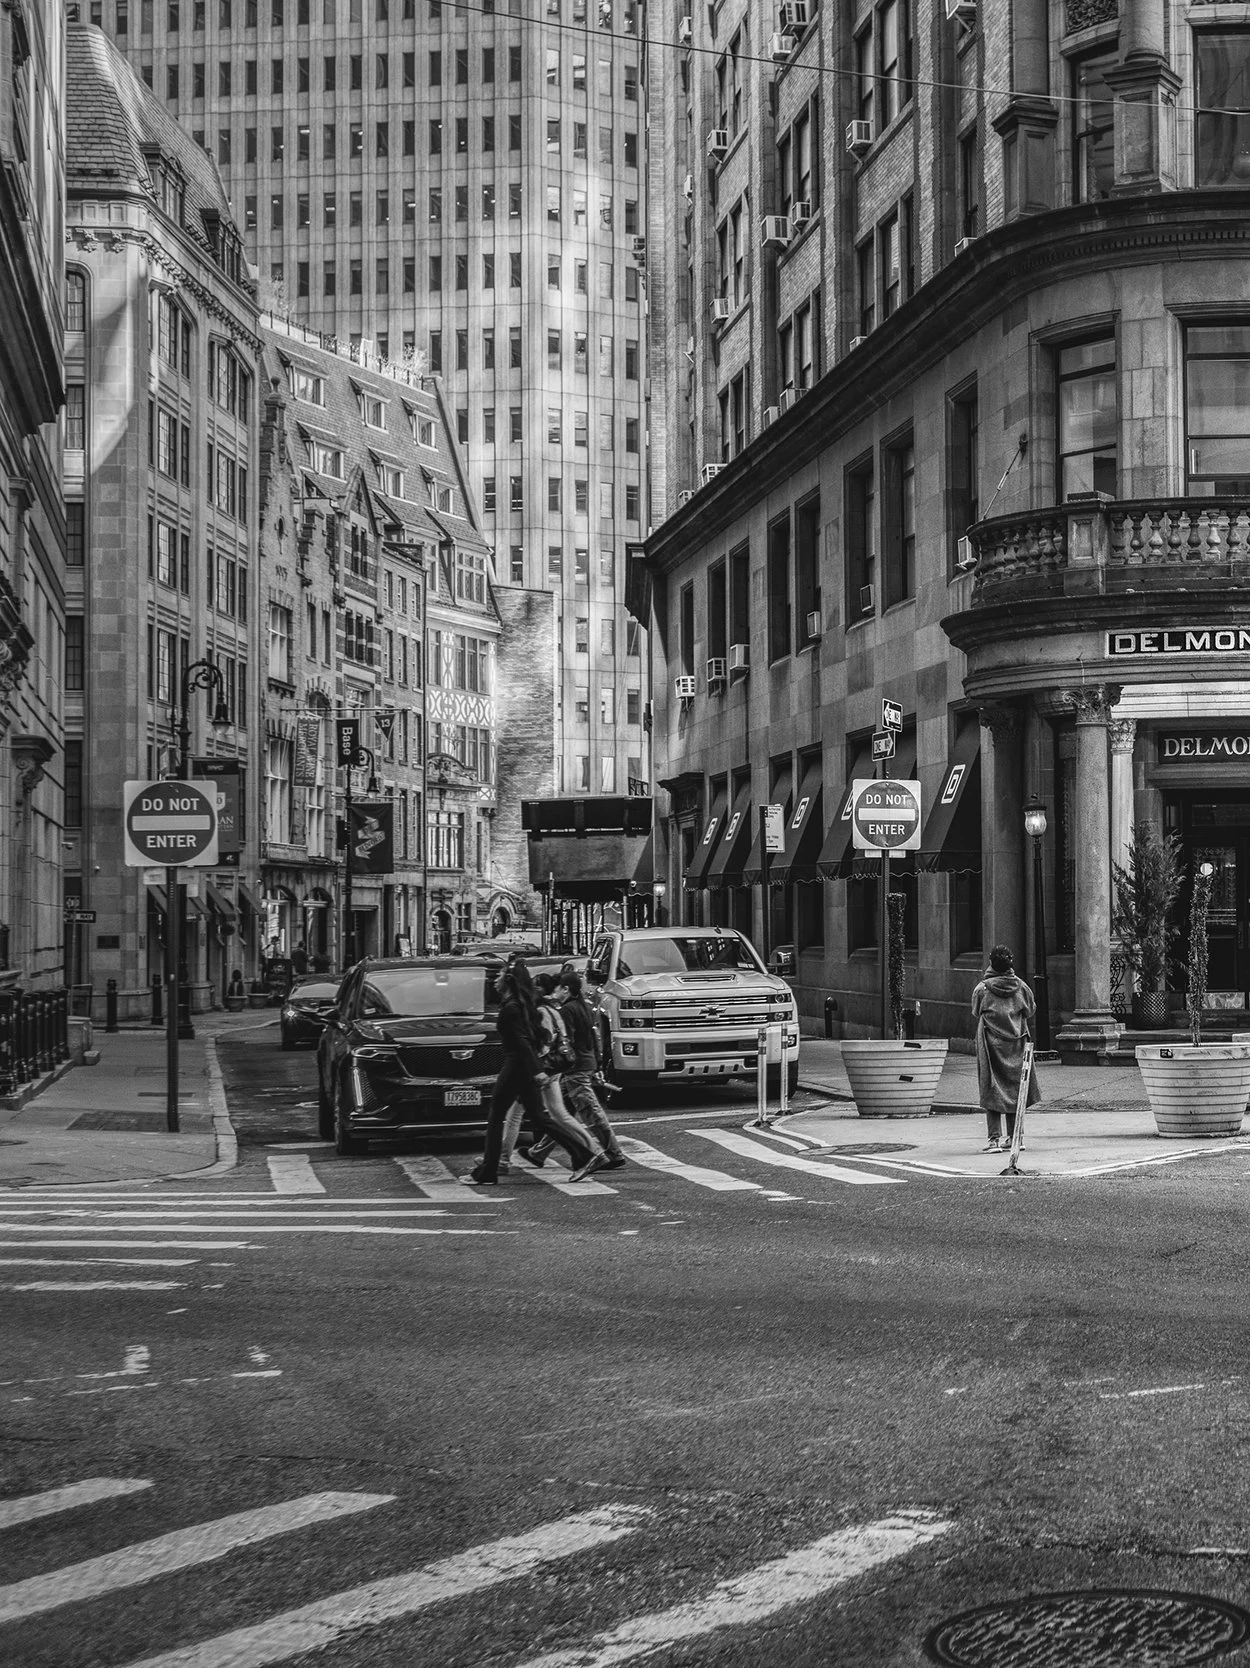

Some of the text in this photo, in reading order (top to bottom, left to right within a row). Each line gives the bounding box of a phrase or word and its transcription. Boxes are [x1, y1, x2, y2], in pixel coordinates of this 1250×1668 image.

[141, 798, 200, 811] DO NOT
[865, 794, 908, 805] DO NOT
[868, 824, 906, 836] ENTER
[146, 834, 198, 848] ENTER
